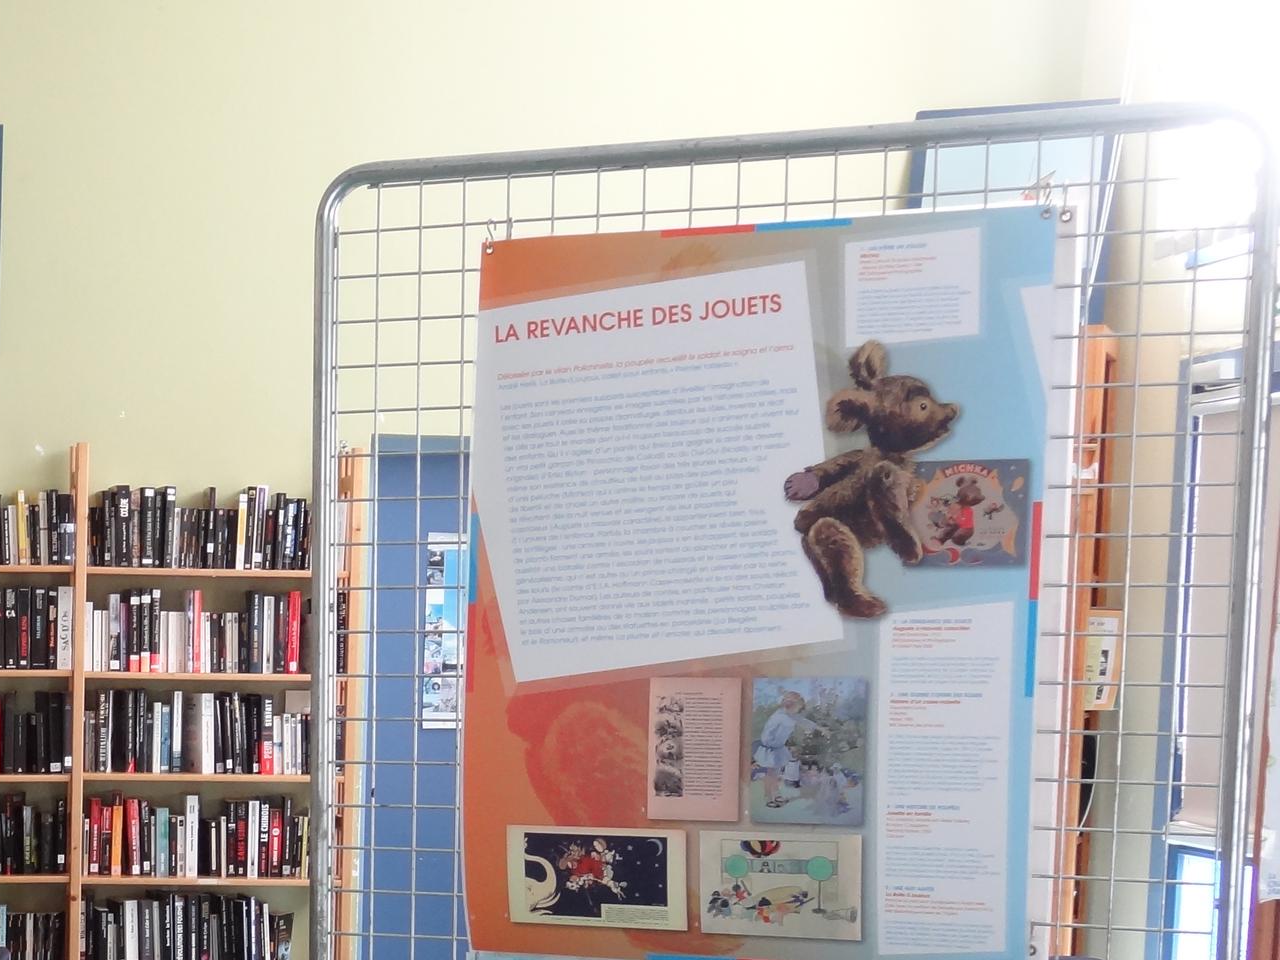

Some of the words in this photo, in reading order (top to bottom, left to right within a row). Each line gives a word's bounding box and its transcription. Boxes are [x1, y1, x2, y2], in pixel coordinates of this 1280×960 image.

[495, 323, 519, 343] LA
[526, 308, 643, 339] REVANCHE
[652, 303, 692, 325] DES
[699, 294, 782, 321] JOUETS
[263, 741, 272, 759] PEUR
[261, 803, 269, 832] CHINOIS
[261, 833, 268, 842] LE
